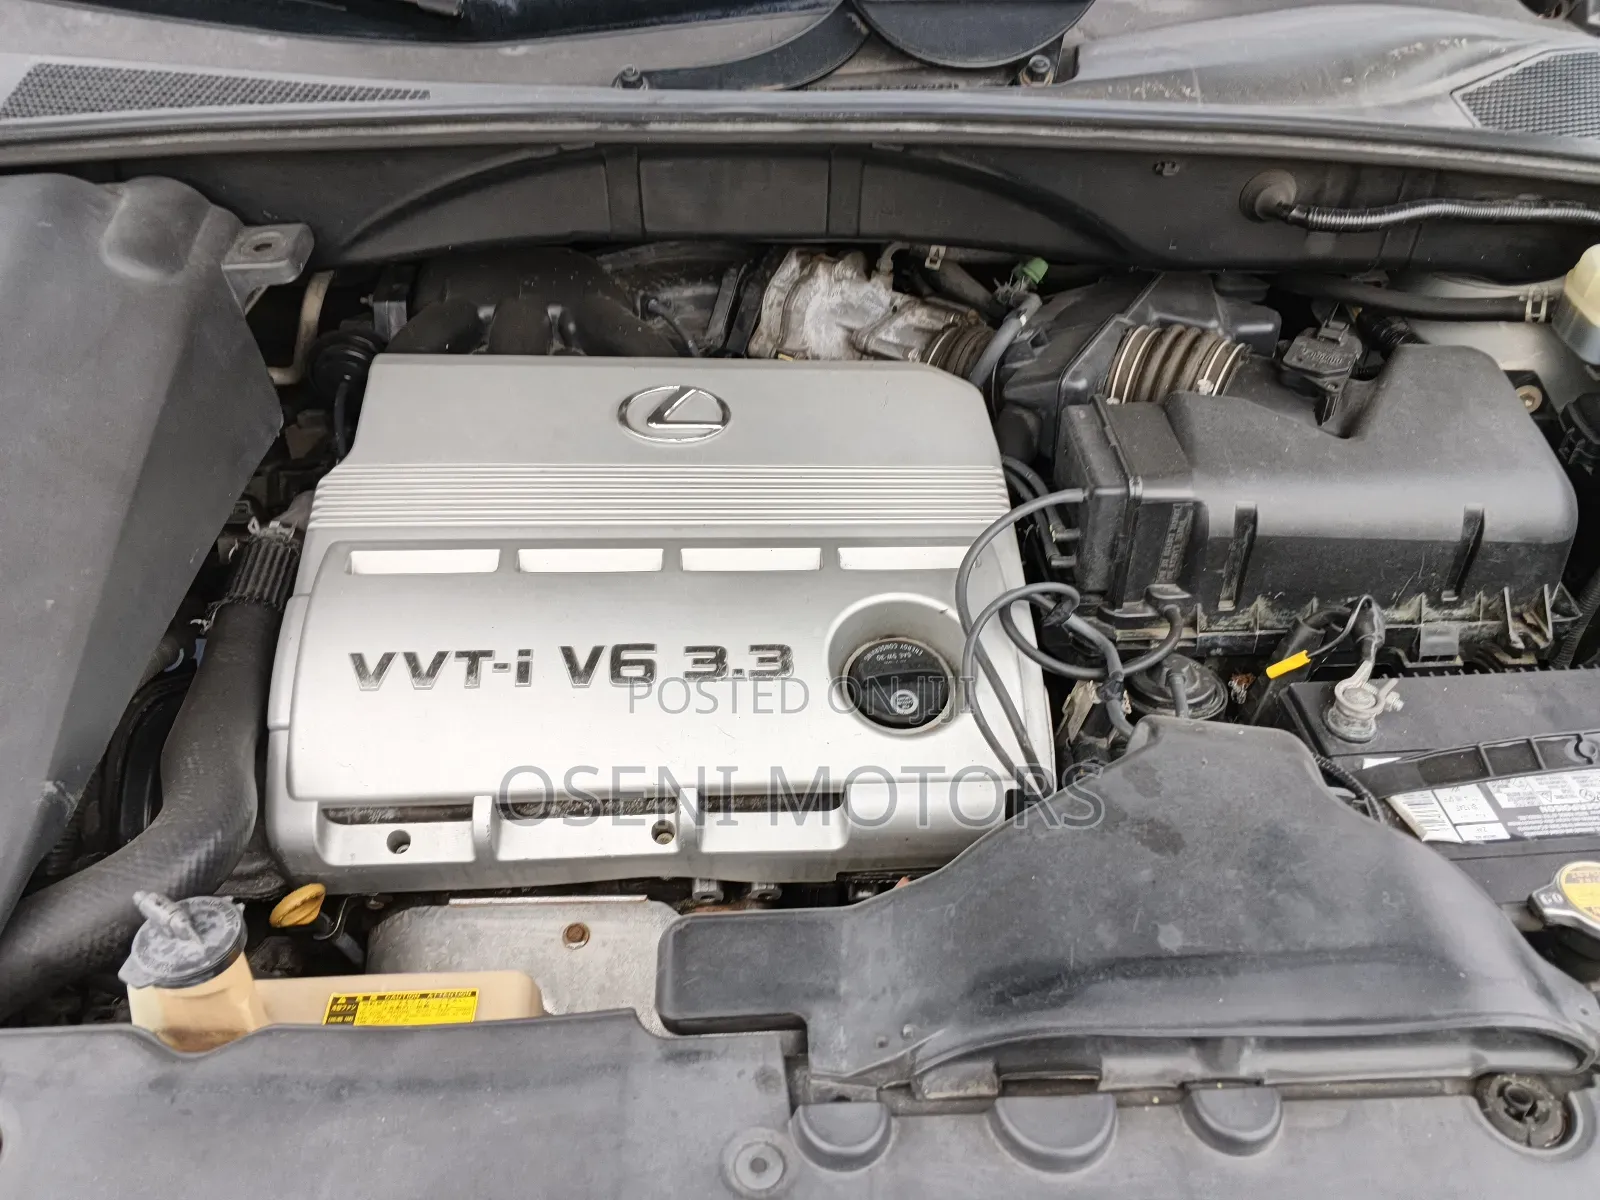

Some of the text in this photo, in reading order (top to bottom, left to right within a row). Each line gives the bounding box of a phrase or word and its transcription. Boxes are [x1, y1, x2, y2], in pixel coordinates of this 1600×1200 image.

[348, 643, 795, 691] VVT-i V6 3.3
